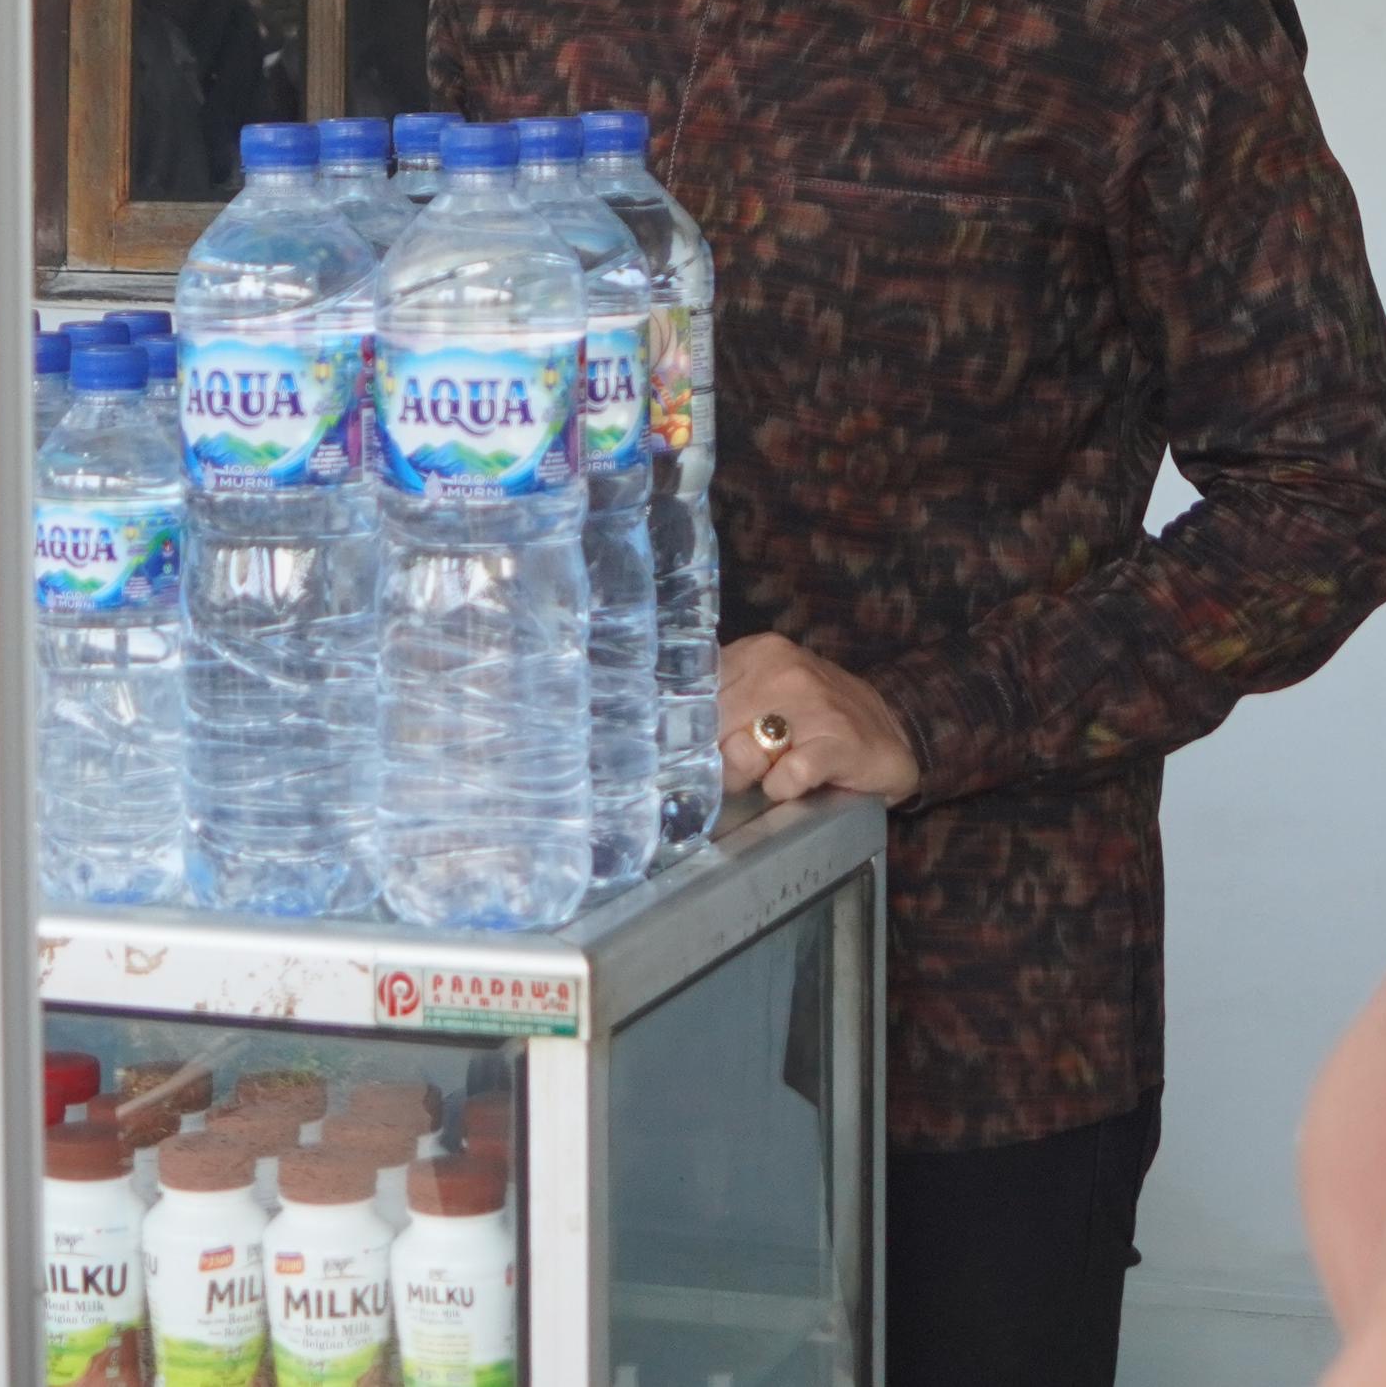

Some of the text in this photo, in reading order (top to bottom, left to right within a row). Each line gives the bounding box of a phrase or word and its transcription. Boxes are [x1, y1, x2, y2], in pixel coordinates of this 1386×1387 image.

[187, 367, 305, 428] AQUA
[399, 377, 535, 437] AQUA
[219, 476, 273, 488] MURNI
[447, 485, 504, 497] MURNI
[35, 523, 118, 569] AQUA
[432, 974, 570, 1001] PANDAWA
[47, 1262, 128, 1298] ILKU
[75, 1299, 105, 1313] Milk
[284, 1279, 389, 1320] MILKU
[407, 1283, 474, 1308] MILKU
[305, 1323, 371, 1338] Real Milk
